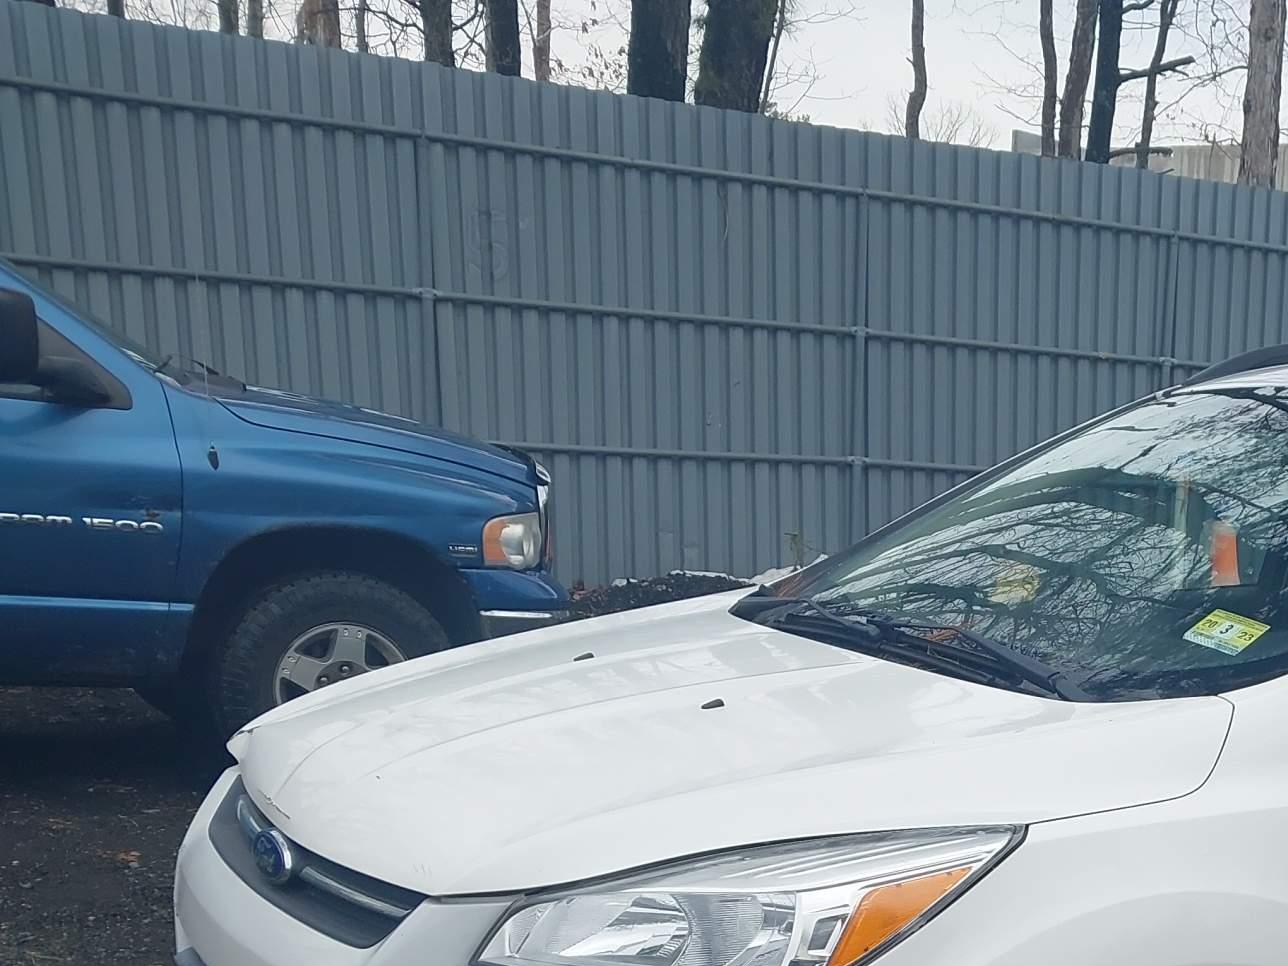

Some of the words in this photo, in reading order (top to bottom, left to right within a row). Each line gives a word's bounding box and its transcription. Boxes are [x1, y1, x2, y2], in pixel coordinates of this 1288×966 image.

[82, 517, 164, 534] 1500
[1202, 619, 1219, 629] 20
[1219, 624, 1235, 635] 3
[1237, 631, 1255, 642] 23
